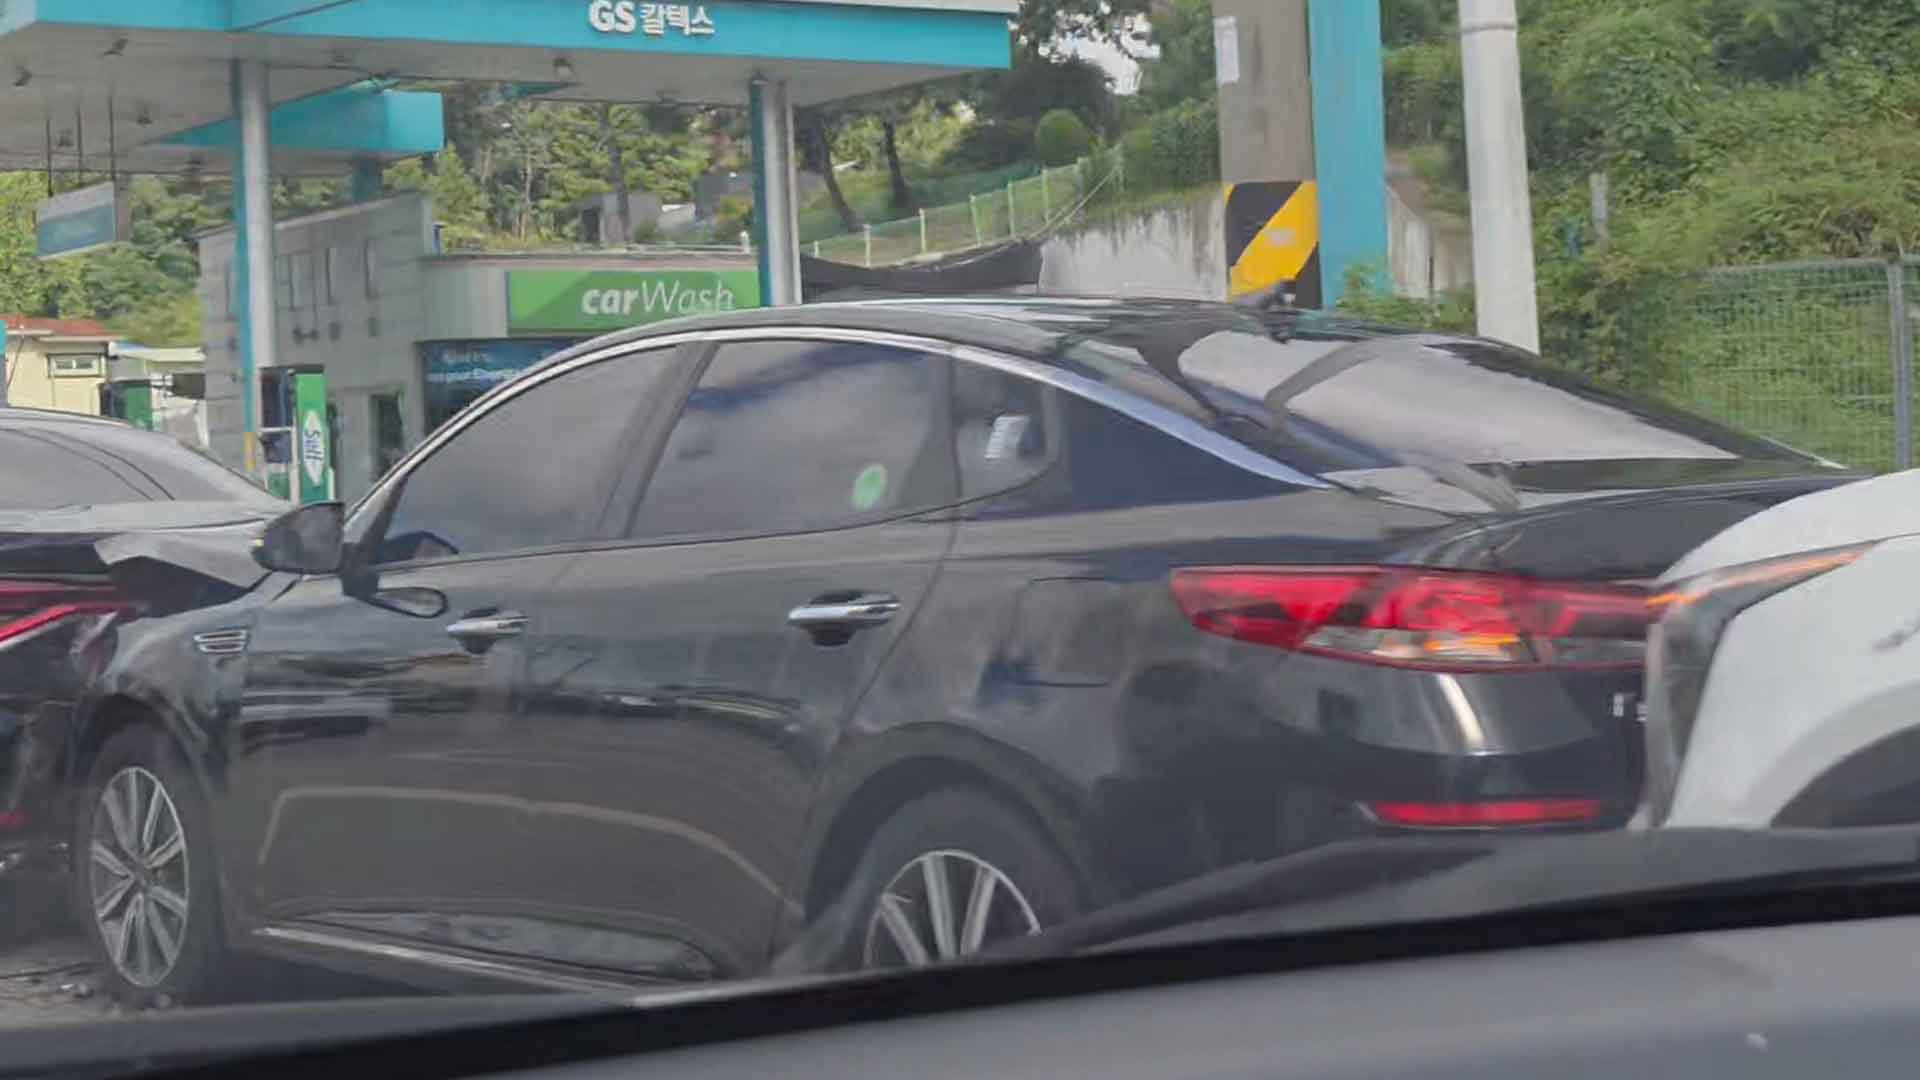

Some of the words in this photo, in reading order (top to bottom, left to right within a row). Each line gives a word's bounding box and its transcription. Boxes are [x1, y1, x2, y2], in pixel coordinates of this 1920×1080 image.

[588, 0, 636, 33] GS
[640, 3, 715, 35] 칼텍스
[581, 280, 735, 315] carWash
